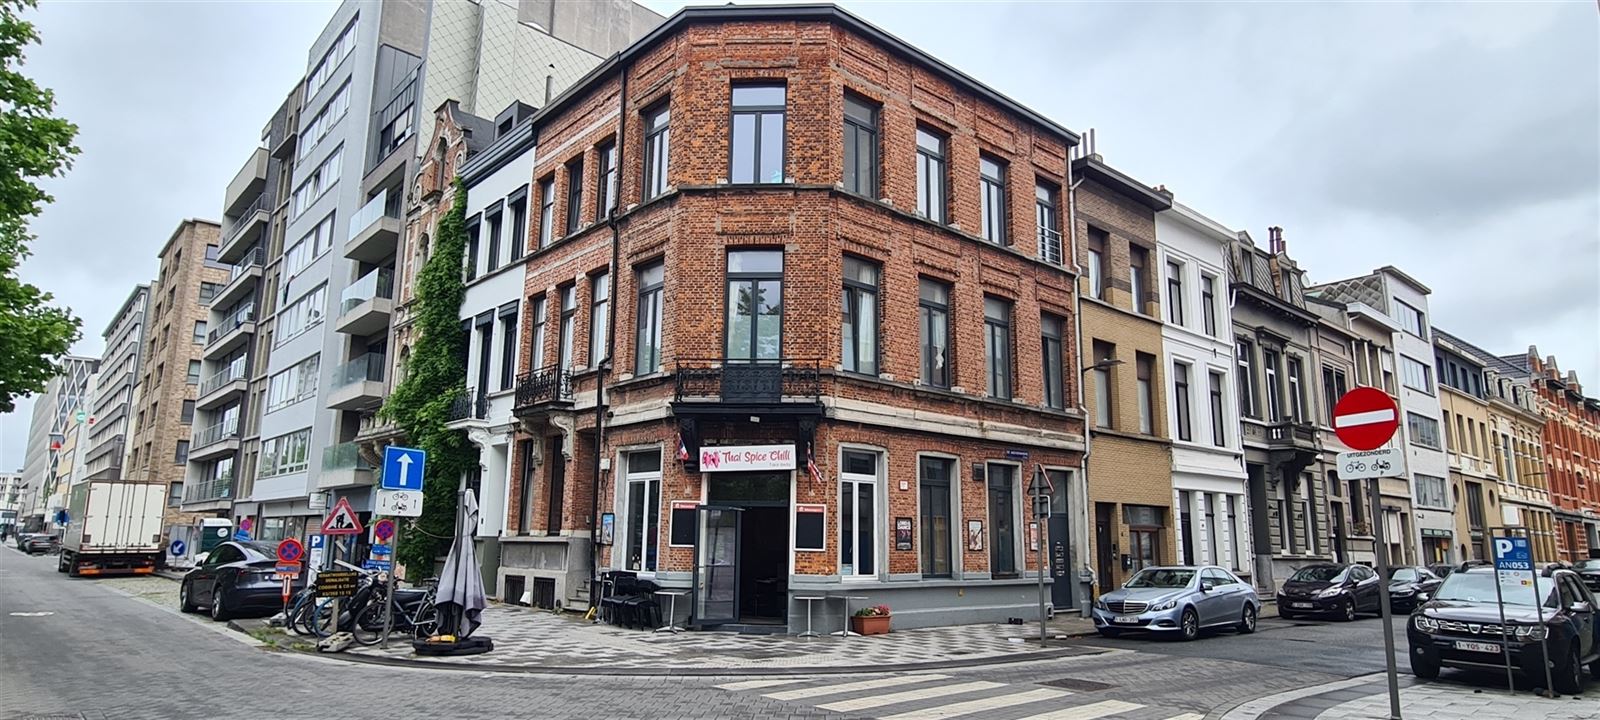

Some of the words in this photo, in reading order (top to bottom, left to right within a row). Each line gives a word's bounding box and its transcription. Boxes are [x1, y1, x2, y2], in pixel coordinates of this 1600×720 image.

[722, 450, 741, 464] Thai
[744, 450, 767, 465] Spice
[1347, 450, 1391, 458] UITGEZONDERD
[312, 536, 321, 547] P
[1495, 539, 1513, 558] P
[1500, 562, 1530, 570] AN053
